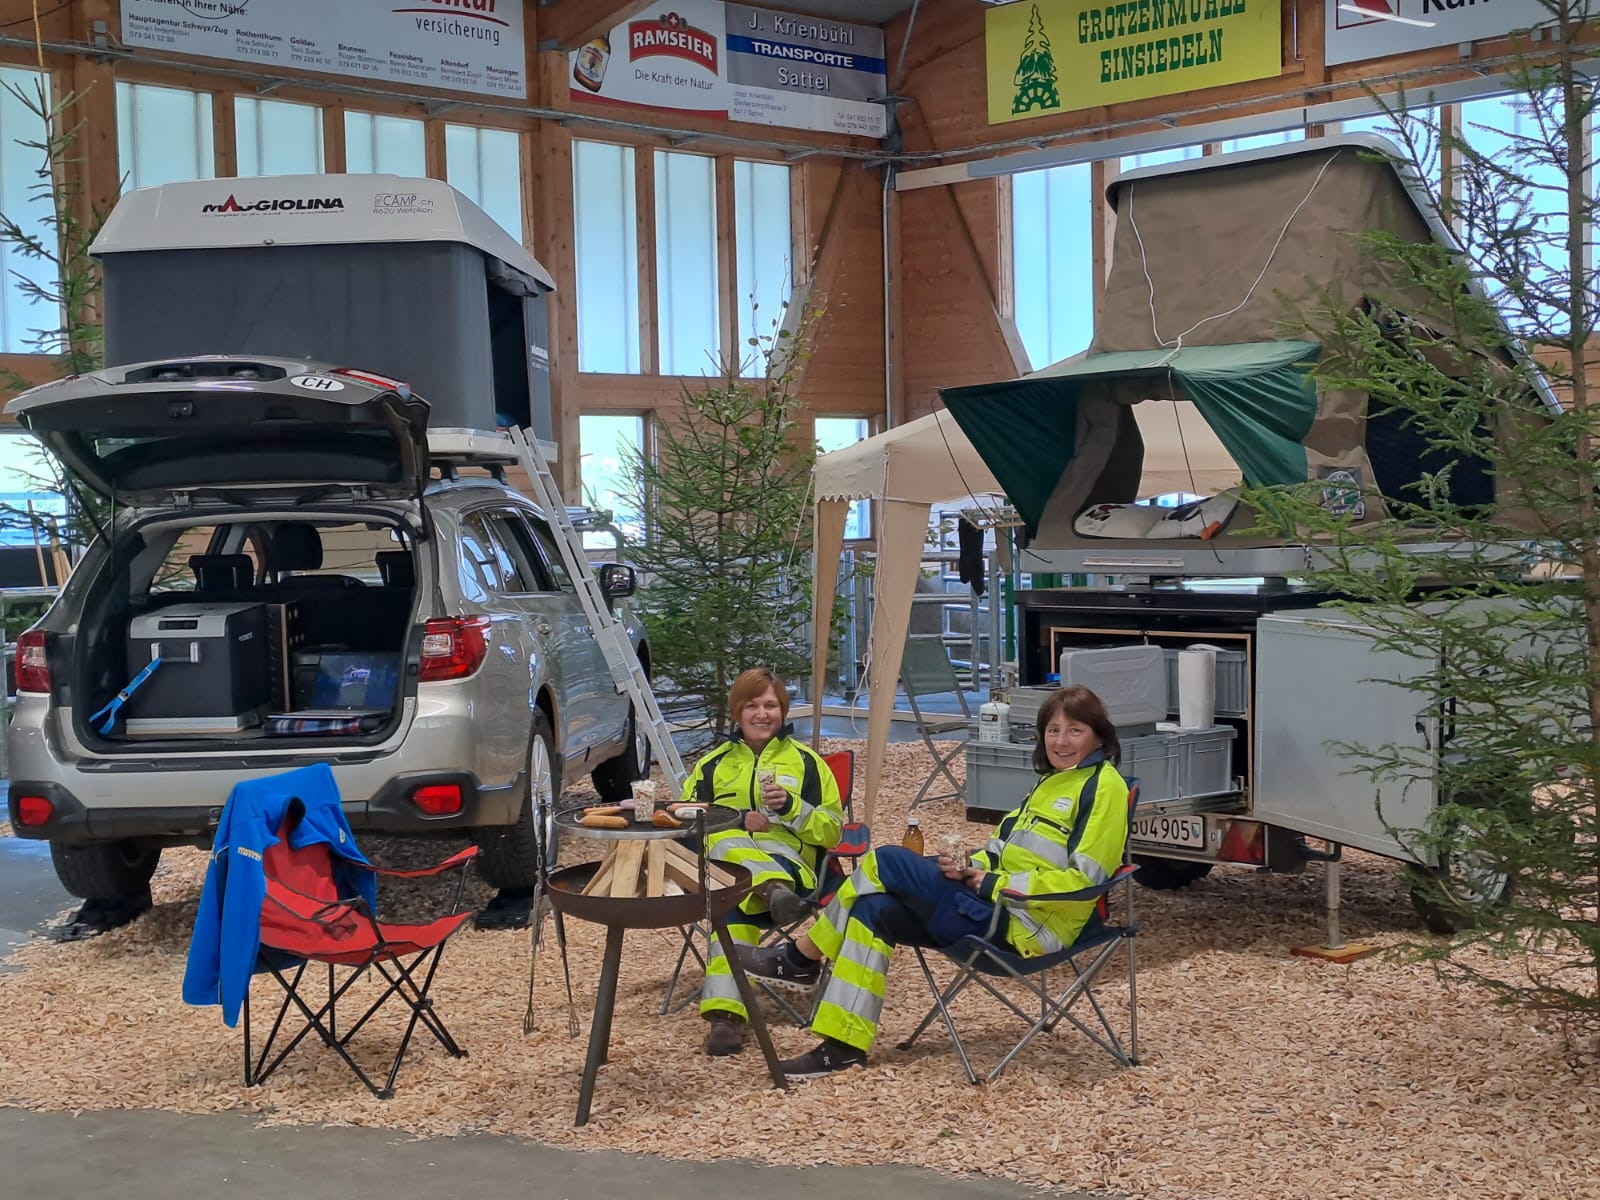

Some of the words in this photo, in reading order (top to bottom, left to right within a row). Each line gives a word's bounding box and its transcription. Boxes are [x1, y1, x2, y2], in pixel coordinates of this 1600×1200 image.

[195, 0, 217, 11] Ihrer
[220, 3, 248, 16] Nähe:
[129, 13, 180, 27] Hauptagentur
[183, 21, 228, 35] Schwyz/Zug
[416, 17, 500, 46] versicherung
[748, 12, 764, 31] J.
[774, 15, 855, 45] Krienbühl
[236, 29, 283, 42] Rothenthurm
[290, 37, 316, 47] Goldau
[633, 29, 713, 61] RAMSEIER
[338, 43, 366, 54] Brunnen
[752, 41, 854, 68] TRANSPORTE
[1100, 28, 1223, 83] EINSIEDELN
[440, 59, 469, 69] Altendorf
[635, 69, 649, 81] Die
[652, 71, 673, 84] Kraft
[674, 74, 688, 86] der
[690, 78, 713, 90] Natur
[778, 66, 831, 91] Sattel
[202, 193, 344, 212] MAGGIOLINA
[301, 377, 333, 389] CH
